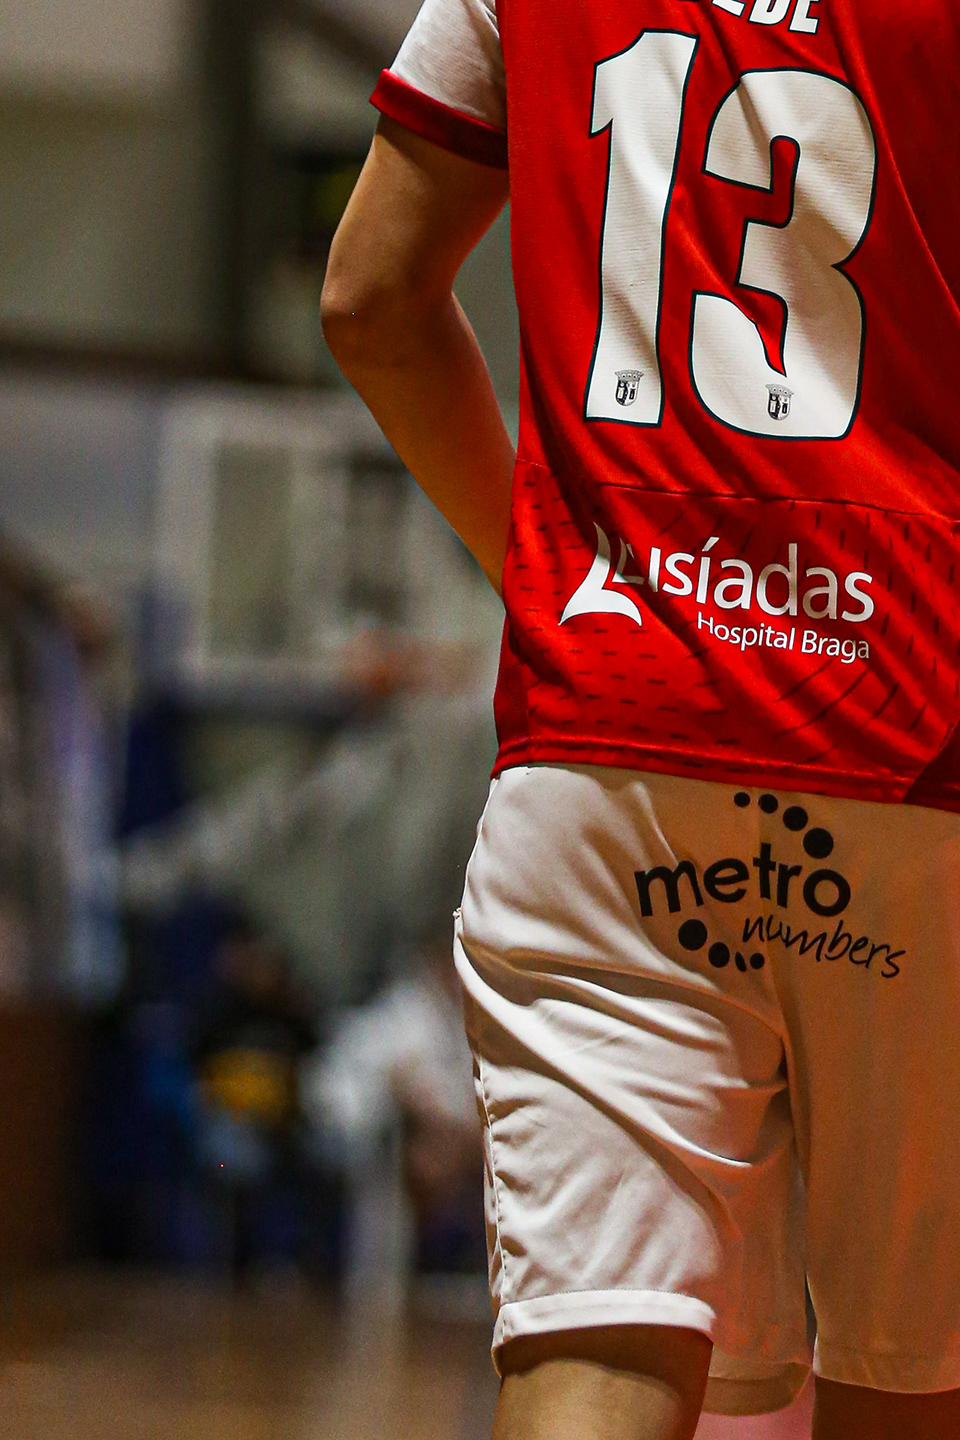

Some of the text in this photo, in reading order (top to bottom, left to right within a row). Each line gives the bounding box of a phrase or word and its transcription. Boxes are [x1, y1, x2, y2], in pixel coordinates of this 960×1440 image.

[583, 28, 879, 441] 13
[697, 611, 870, 664] Hospital Braga
[634, 842, 851, 917] metro
[742, 914, 906, 978] numbers
